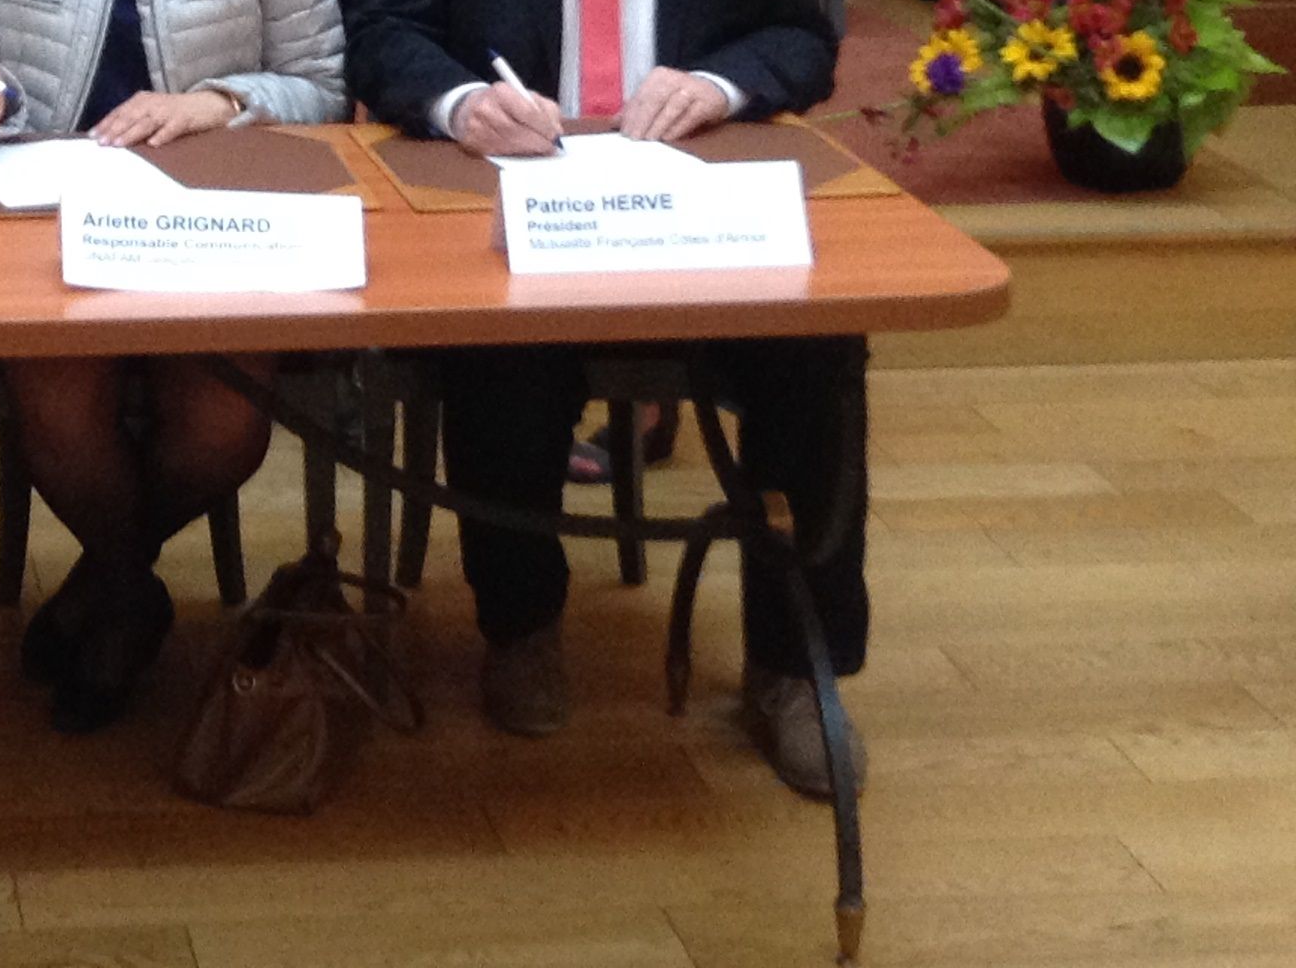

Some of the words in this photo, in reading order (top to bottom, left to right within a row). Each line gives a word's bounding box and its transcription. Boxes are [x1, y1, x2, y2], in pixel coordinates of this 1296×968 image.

[526, 197, 595, 213] Patrice
[601, 193, 673, 210] HERVE
[83, 212, 148, 230] Arlette
[156, 215, 271, 233] GRIGNARD
[527, 220, 598, 231] Président
[83, 234, 178, 249] Responsable
